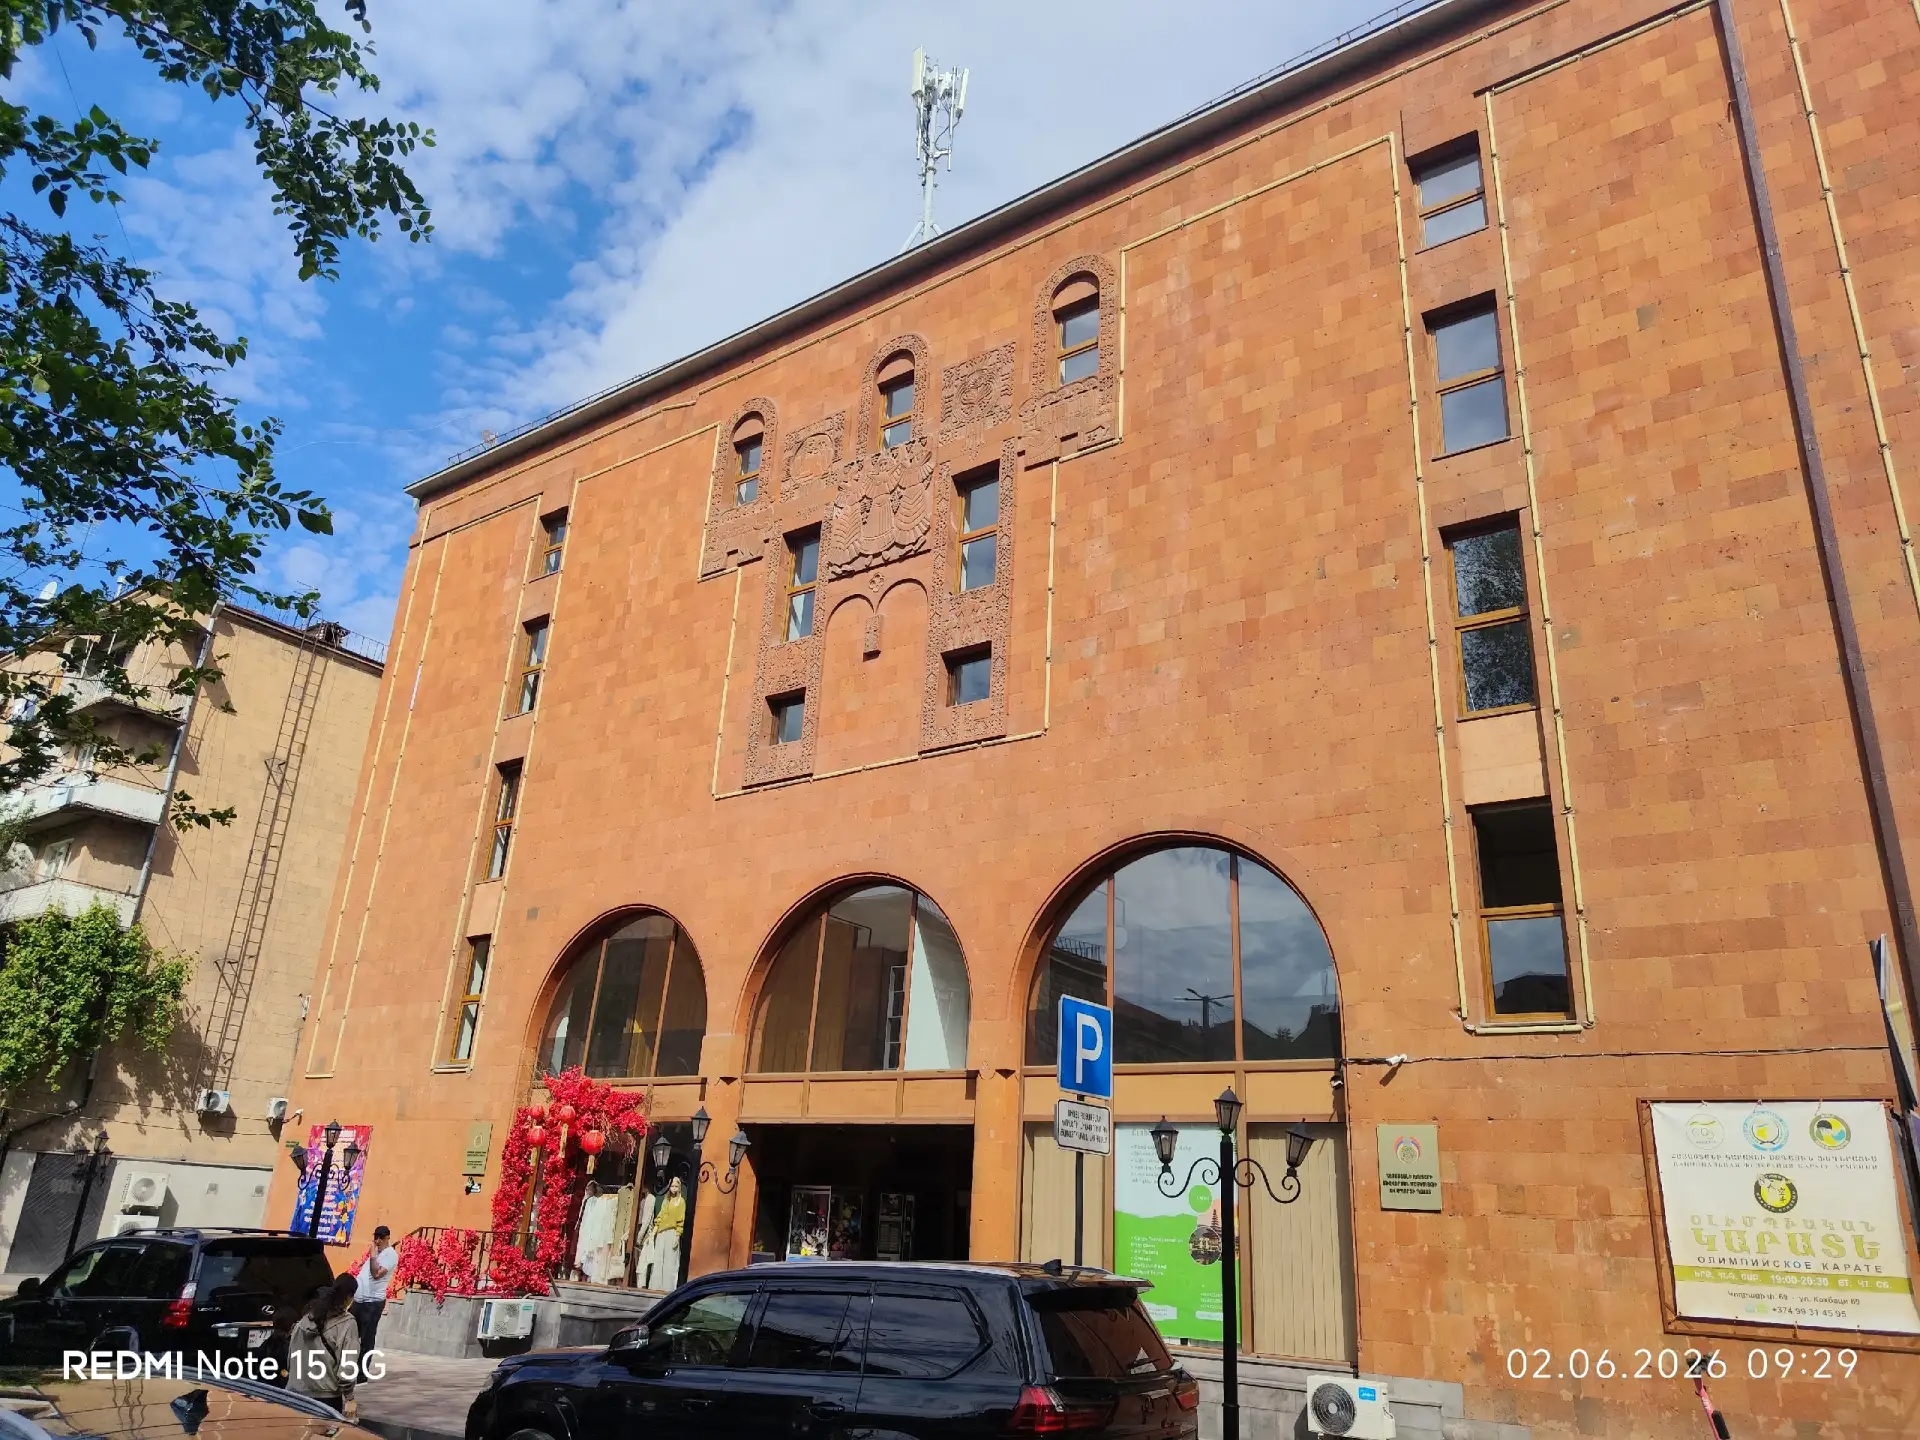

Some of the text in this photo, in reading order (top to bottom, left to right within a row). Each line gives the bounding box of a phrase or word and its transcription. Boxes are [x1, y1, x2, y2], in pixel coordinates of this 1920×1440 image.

[1075, 1012, 1104, 1084] P
[1690, 1214, 1876, 1232] ՕԼԻՄՊԻԱԿԱՆ
[1690, 1227, 1881, 1260] ԿԱՐԱՏԵ
[1821, 1262, 1883, 1273] КАРАТЕ
[1769, 1274, 1830, 1287] 19:00-20:30
[1772, 1306, 1793, 1315] +374
